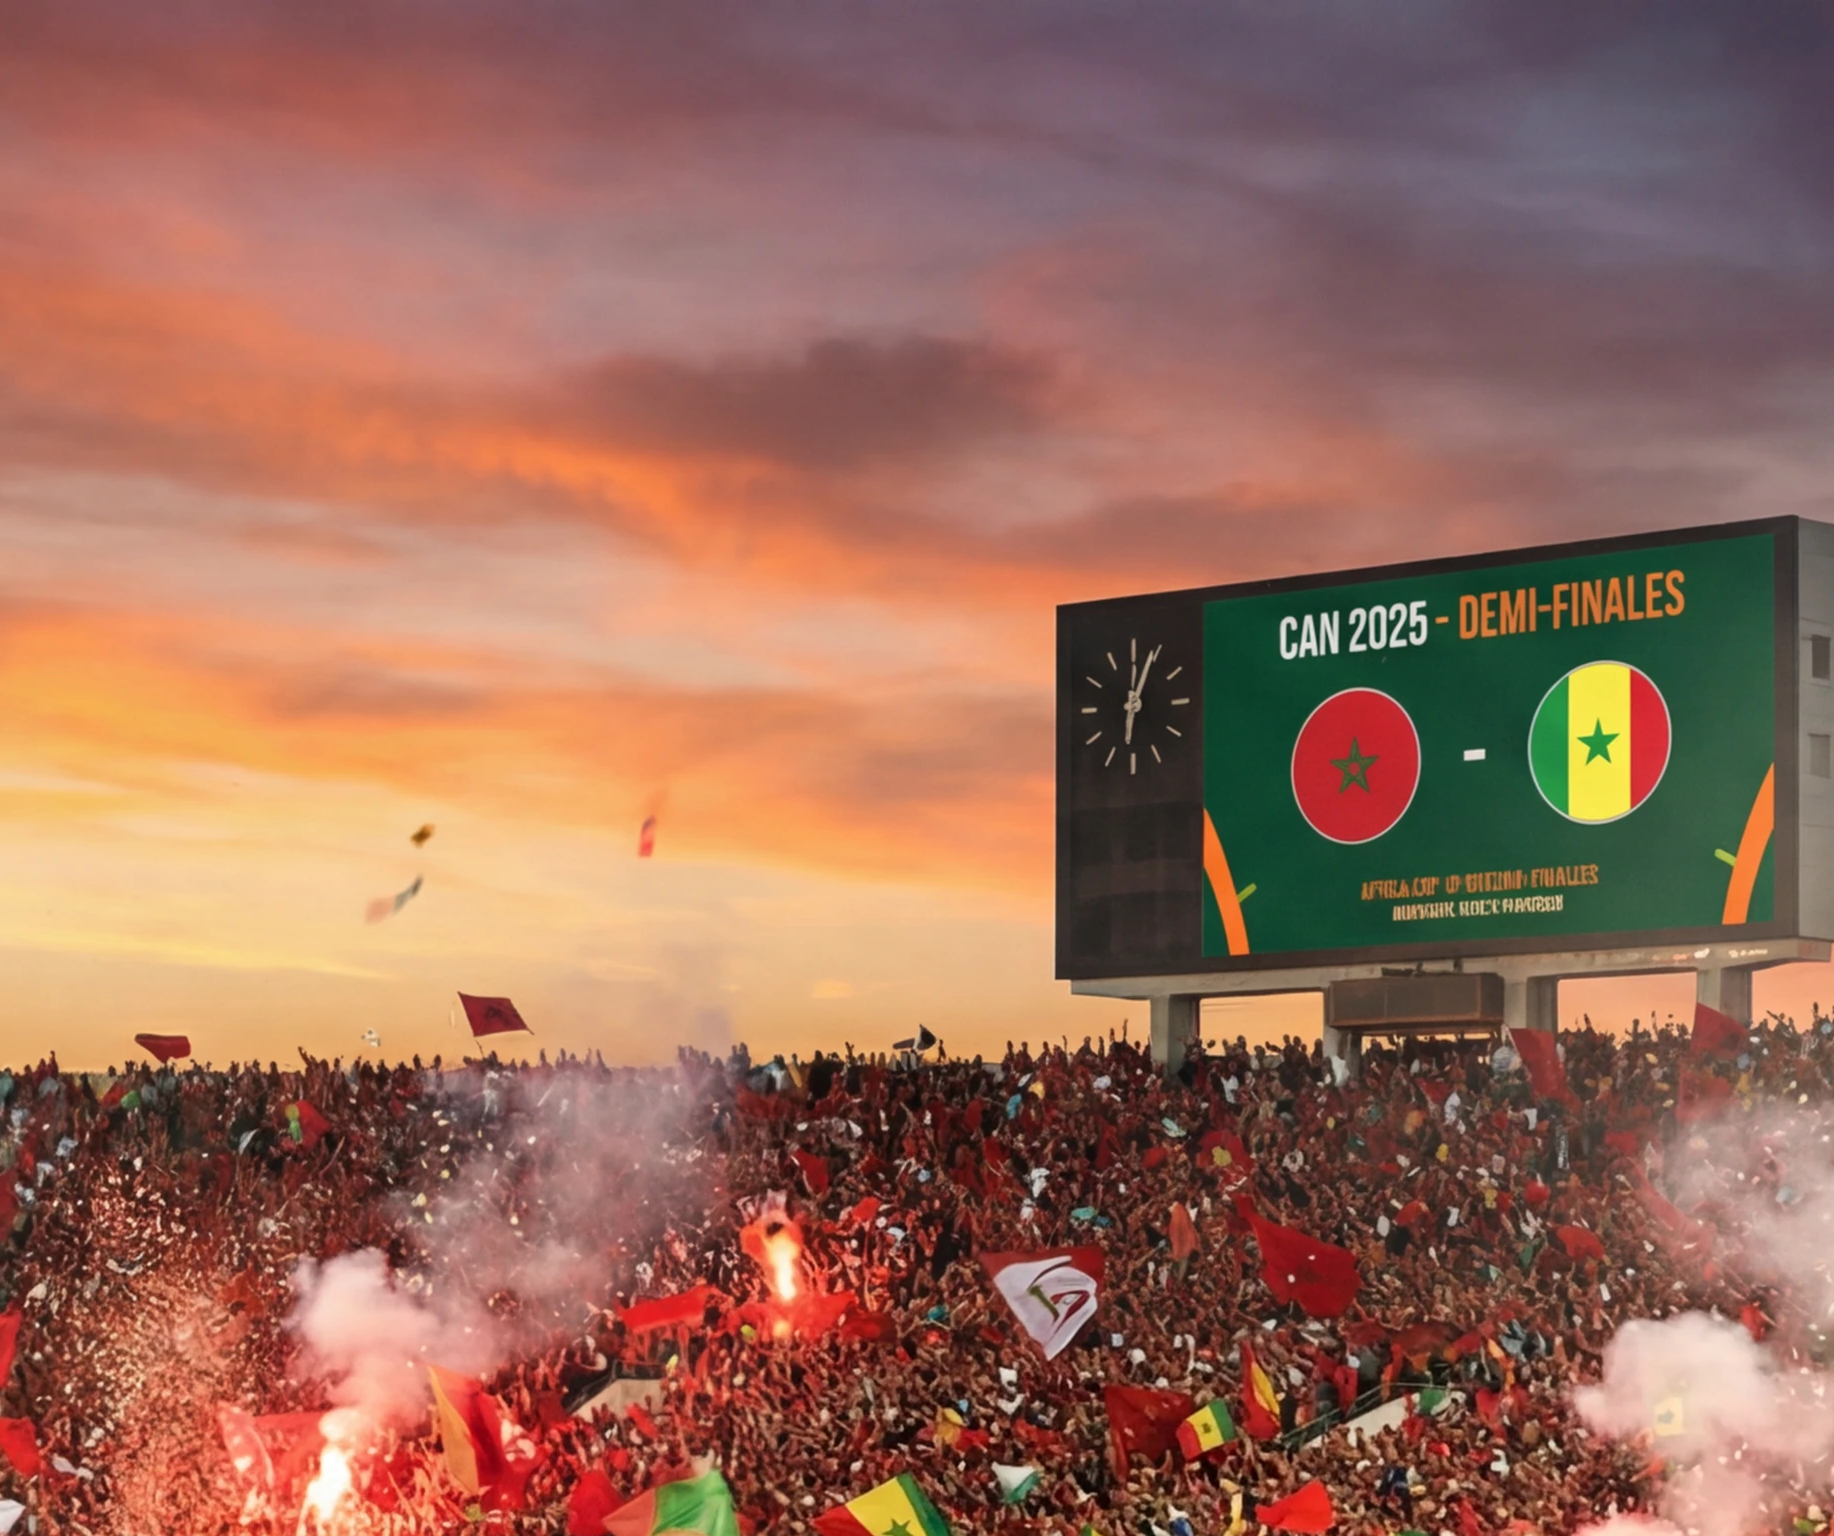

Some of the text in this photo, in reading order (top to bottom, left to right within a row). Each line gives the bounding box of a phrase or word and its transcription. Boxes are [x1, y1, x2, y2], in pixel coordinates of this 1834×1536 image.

[1279, 610, 1340, 660] CAN
[1348, 600, 1428, 653] 2025
[1459, 569, 1686, 640] DEMI-FINALES
